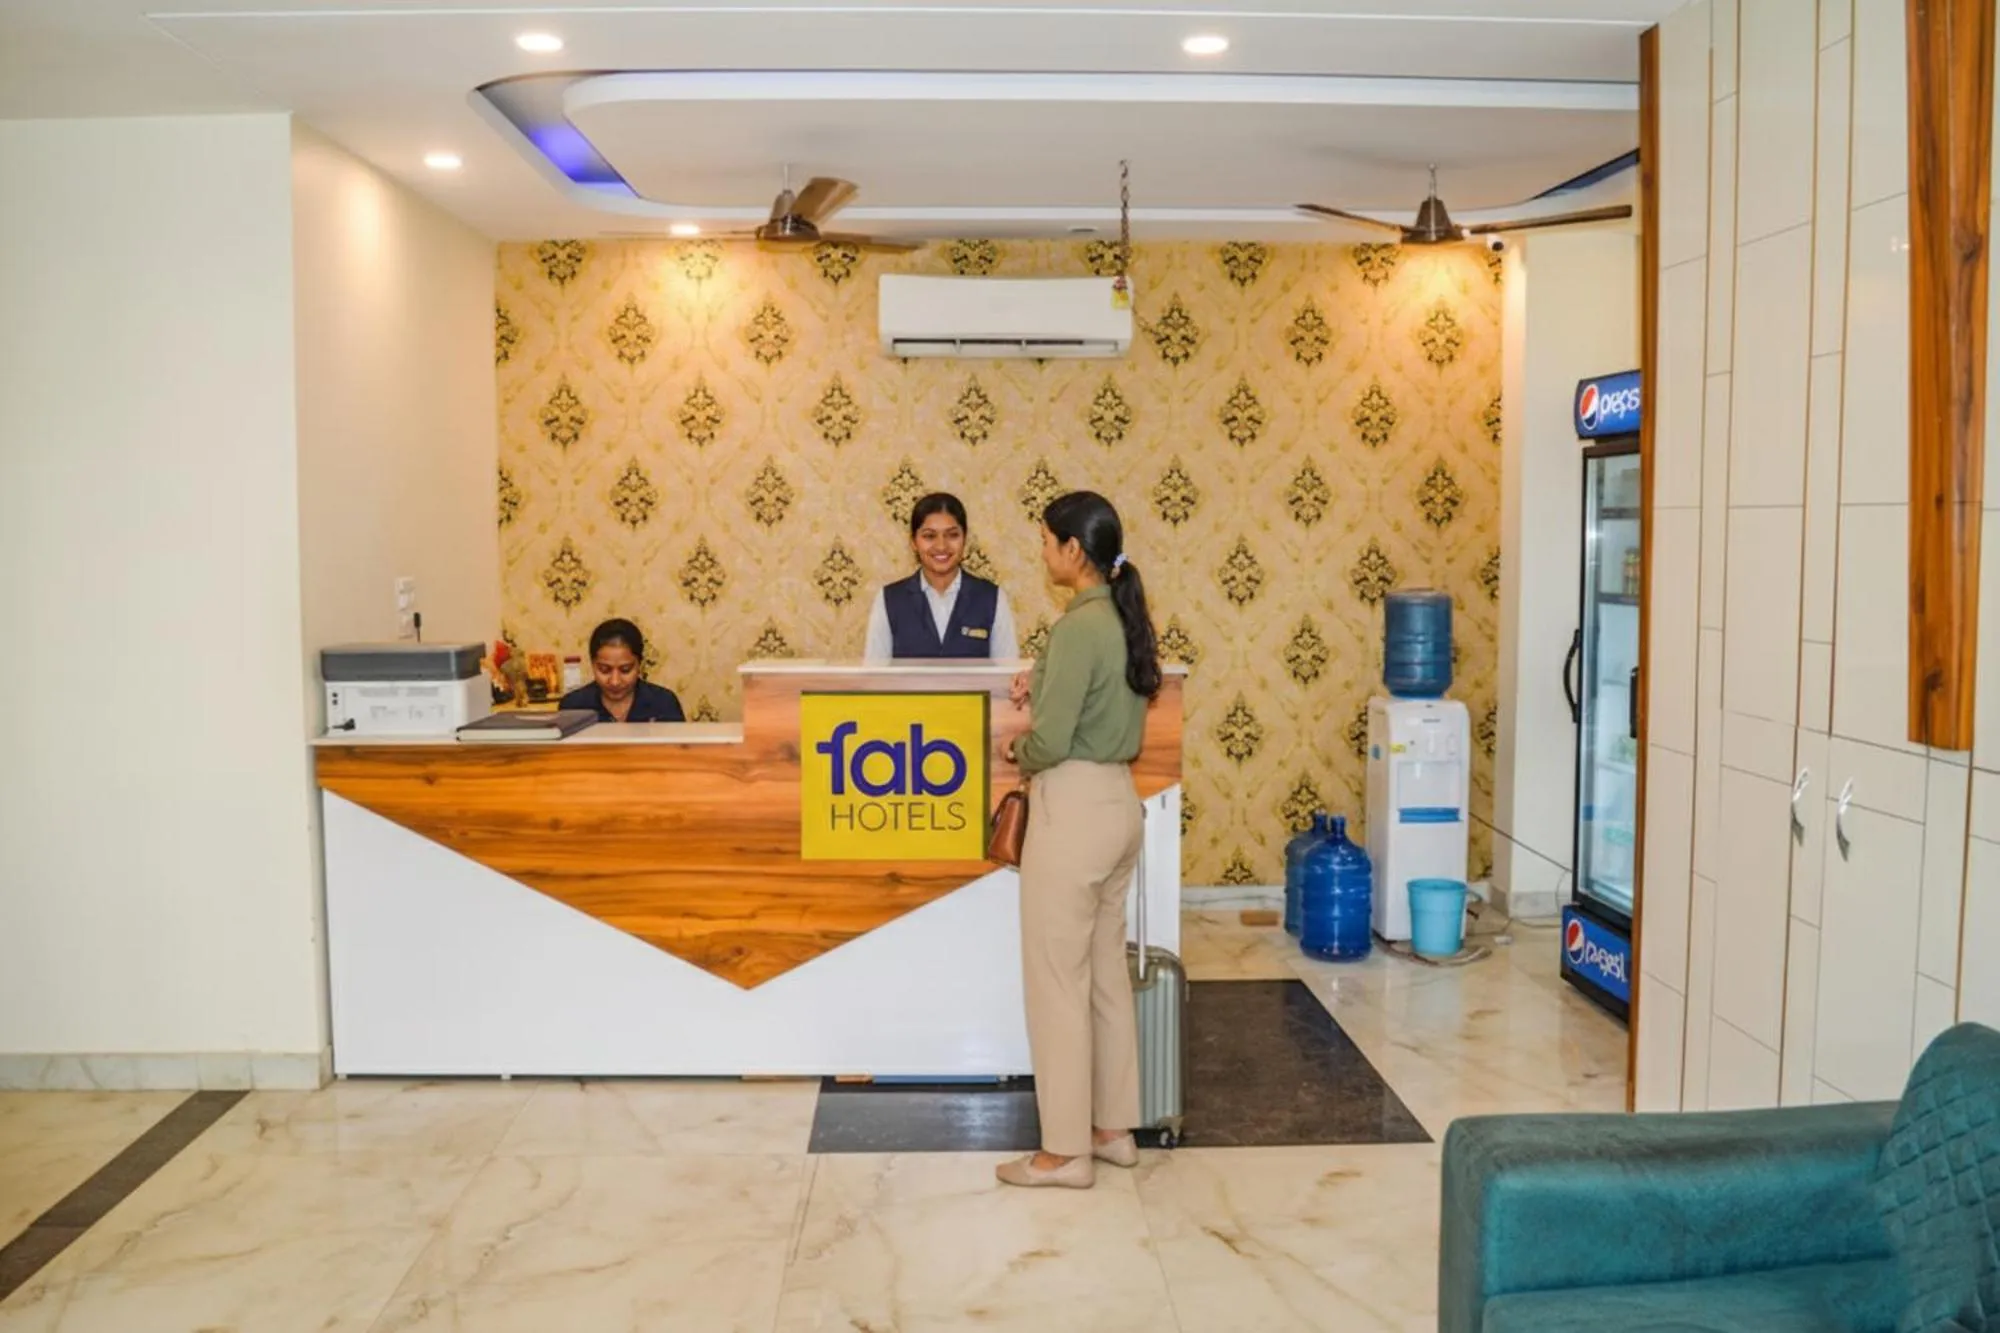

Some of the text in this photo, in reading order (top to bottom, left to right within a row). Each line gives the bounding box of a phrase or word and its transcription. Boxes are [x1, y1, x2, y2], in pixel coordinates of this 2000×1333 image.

[1600, 387, 1641, 423] peps
[816, 721, 967, 797] fab
[831, 801, 967, 832] HOTELS
